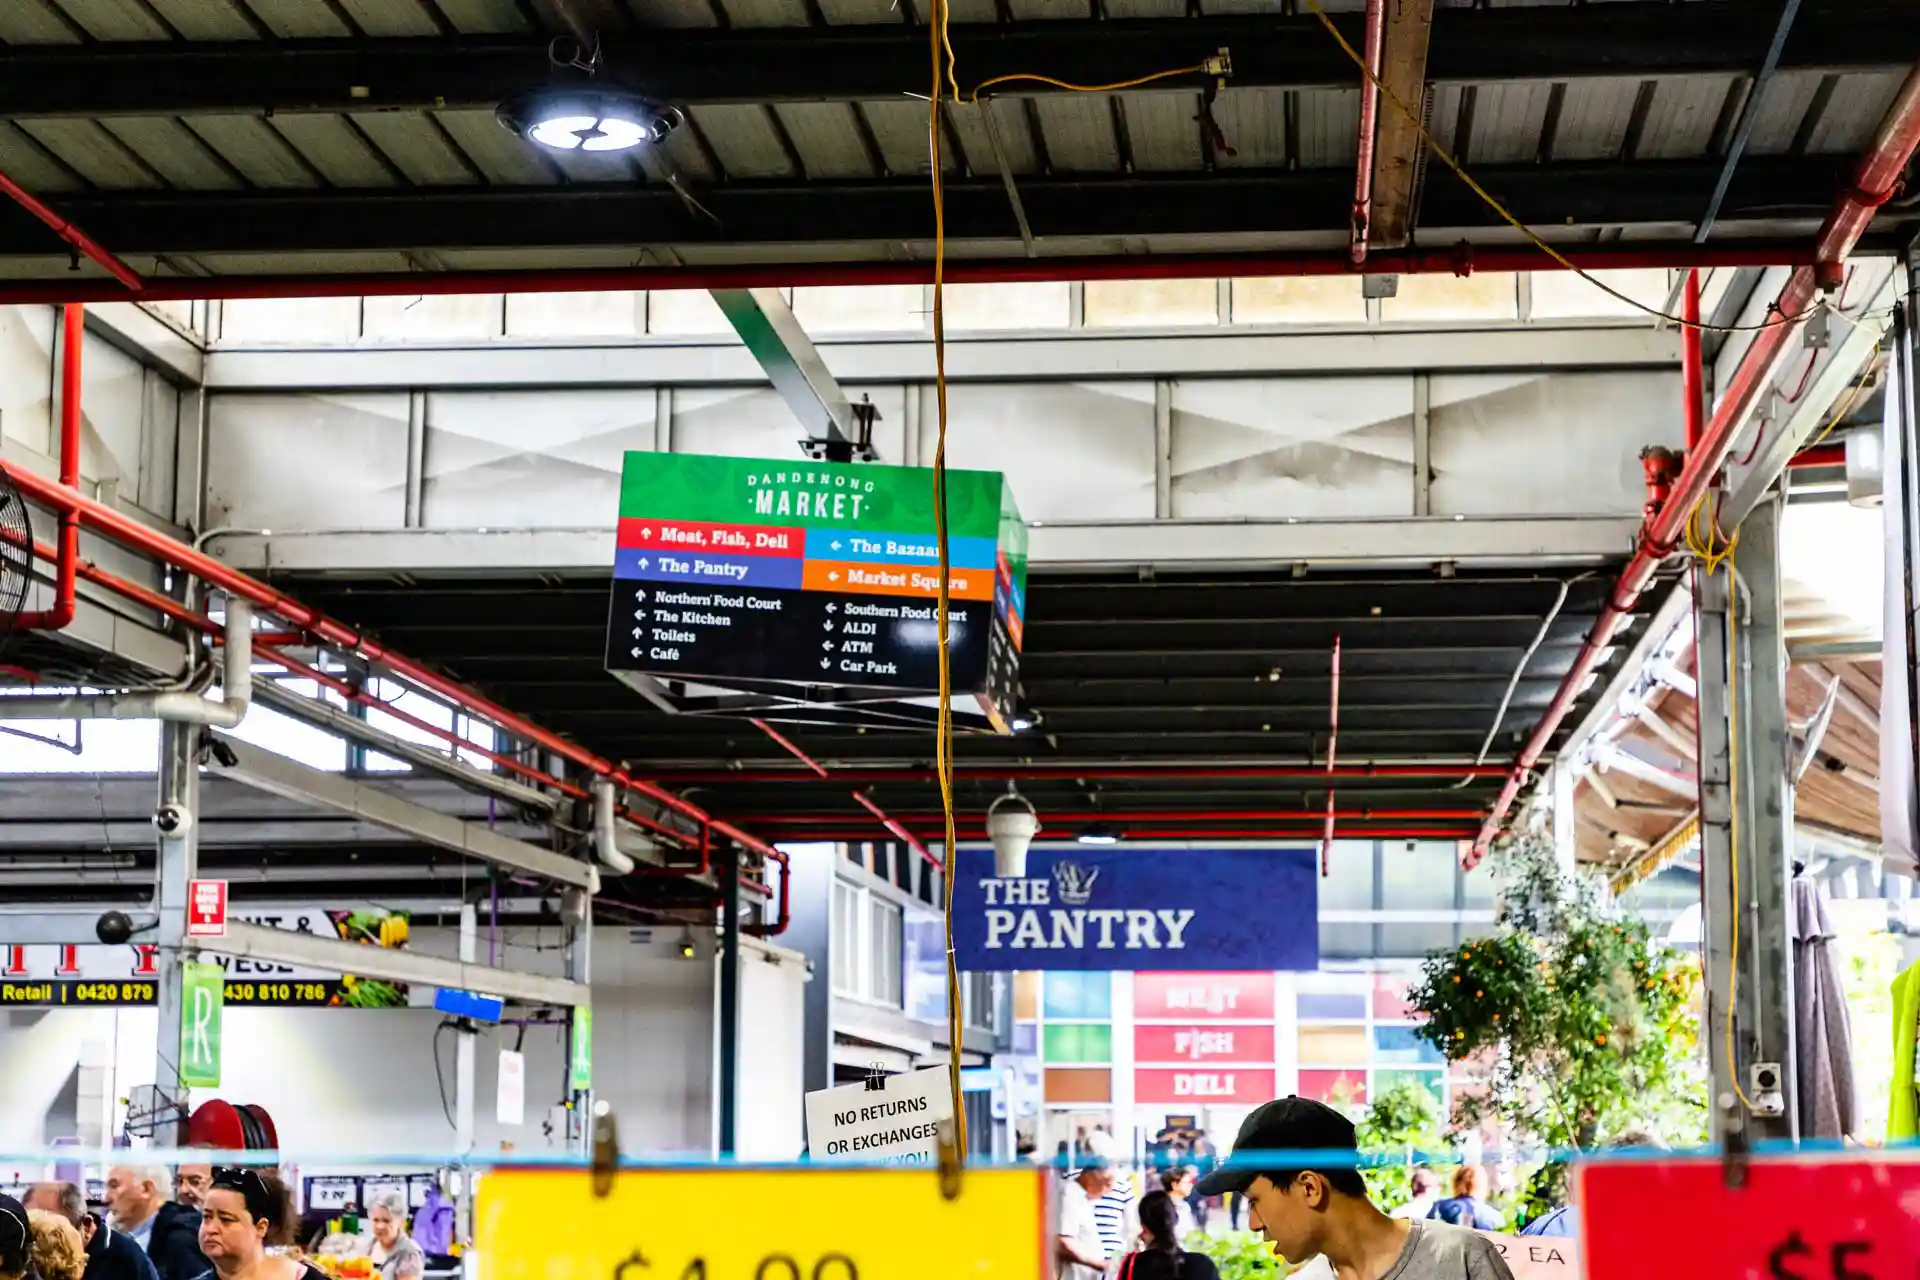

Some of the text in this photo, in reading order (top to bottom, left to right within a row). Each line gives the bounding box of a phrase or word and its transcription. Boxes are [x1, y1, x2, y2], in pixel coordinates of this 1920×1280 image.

[748, 472, 874, 492] DANDENONG
[755, 489, 863, 519] MARKET
[660, 527, 788, 549] Meat, Fish, Deli
[850, 538, 881, 553] The
[658, 557, 748, 580] The Pantry
[848, 569, 968, 591] Market Squre
[655, 591, 782, 610] Northern Food Court
[654, 609, 731, 626] The Kitchen
[844, 602, 967, 622] Southern Food Curt
[652, 628, 696, 643] Toilets
[843, 621, 877, 635] ALDI
[841, 640, 874, 654] ATM
[840, 659, 897, 674] Car Park
[979, 878, 1051, 905] THE
[984, 909, 1195, 949] PANTRY
[2, 984, 153, 1000] Retail 0420 879
[258, 984, 290, 1000] 810
[294, 984, 326, 1000] 786
[193, 987, 213, 1065] R
[1174, 1074, 1236, 1095] DELI
[834, 1097, 928, 1126] NO RETURNS
[827, 1122, 939, 1155] OR EXCHANGES
[1529, 1246, 1566, 1266] EA
